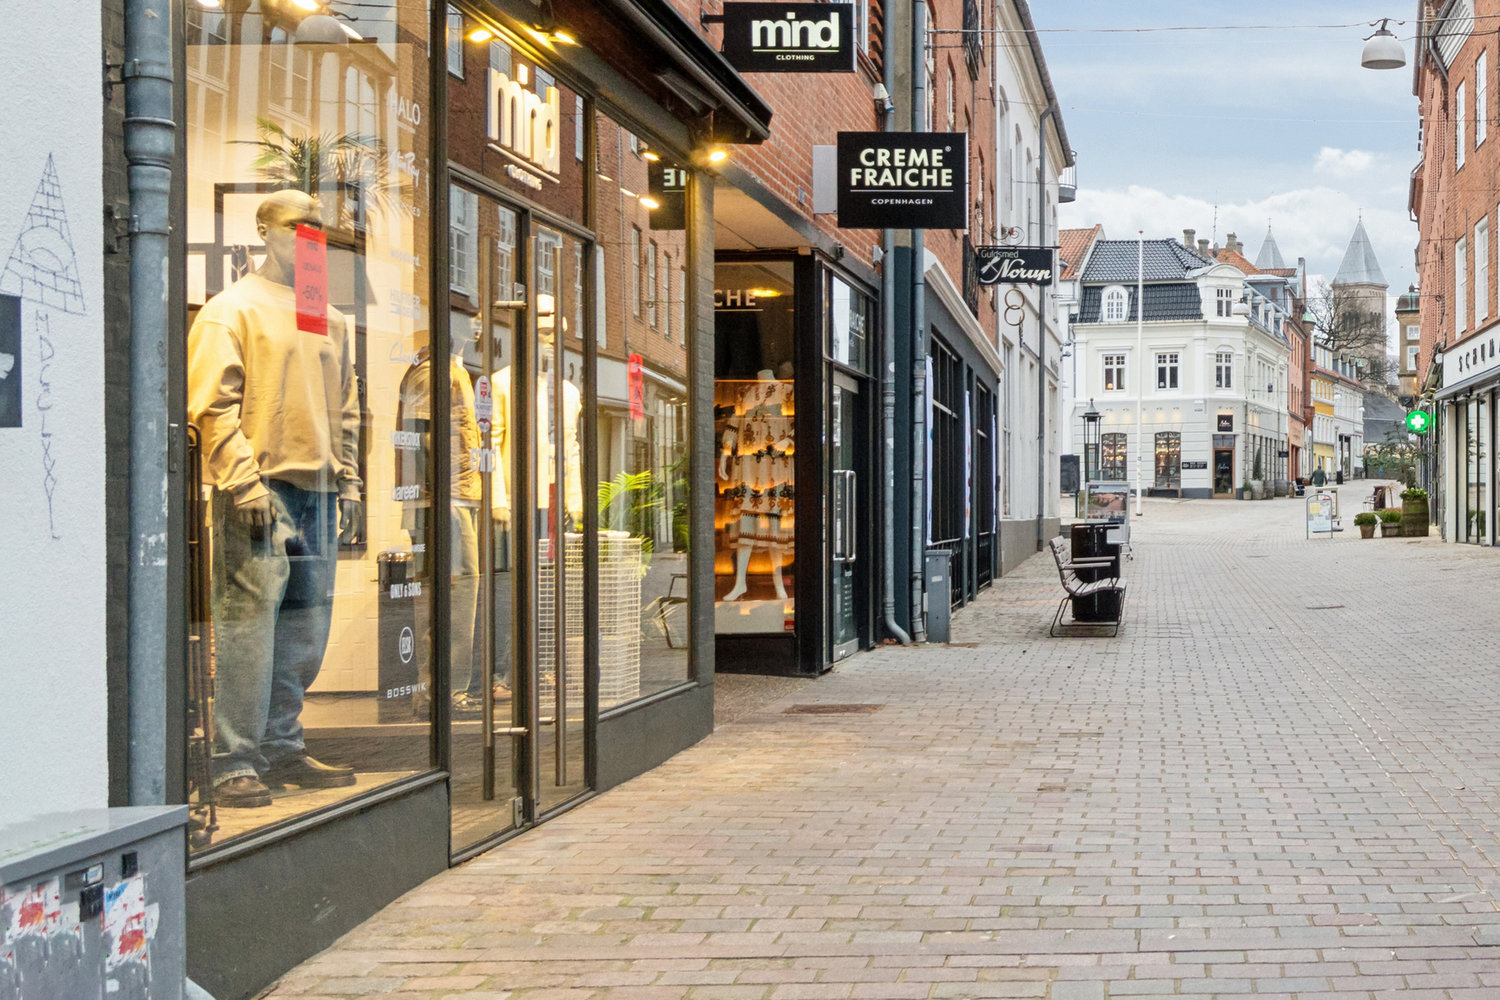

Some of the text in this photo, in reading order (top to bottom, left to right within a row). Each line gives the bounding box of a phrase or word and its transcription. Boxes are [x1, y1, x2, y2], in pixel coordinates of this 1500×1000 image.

[751, 11, 840, 48] mind
[487, 63, 561, 175] mind
[860, 148, 944, 167] CREME
[850, 168, 953, 187] FRAICHE
[980, 250, 1019, 259] Guldsmed
[980, 258, 1052, 284] Norup
[408, 581, 422, 597] SONS
[386, 682, 427, 699] BOSSWIK
